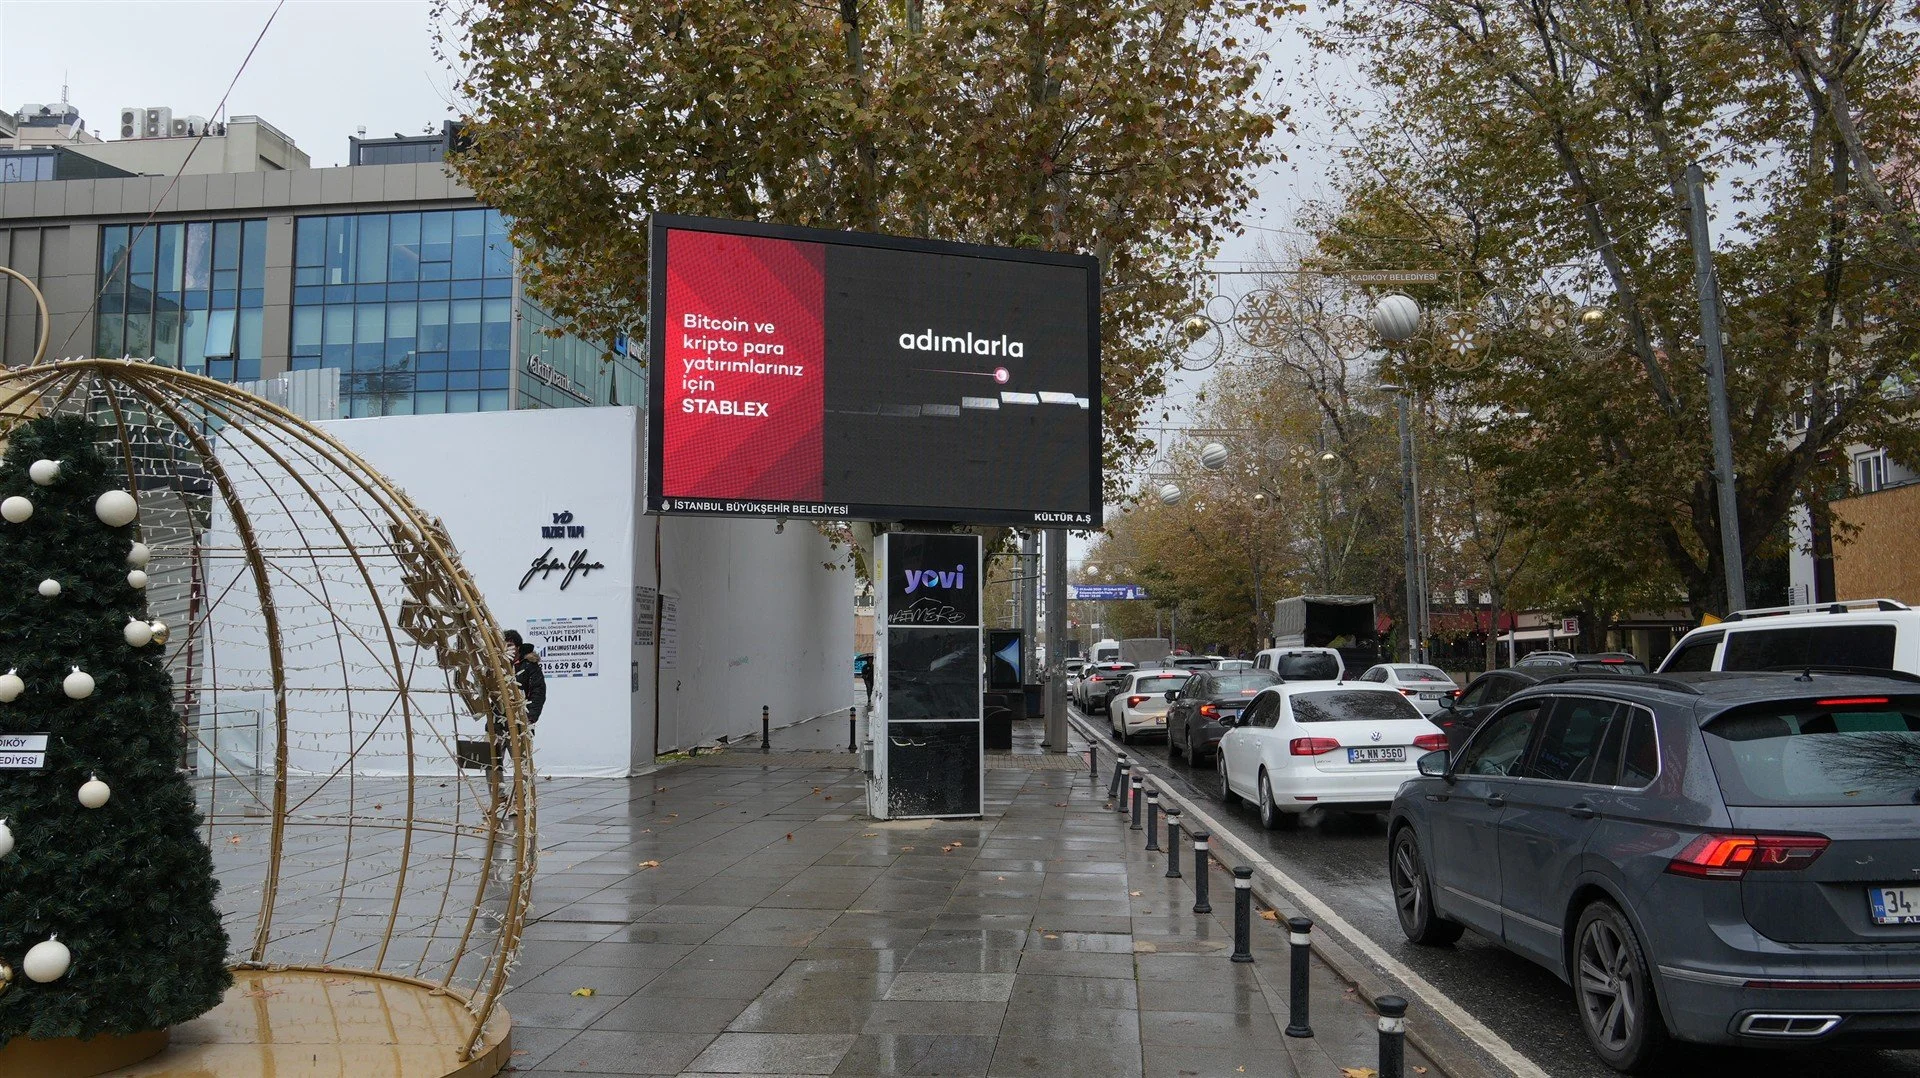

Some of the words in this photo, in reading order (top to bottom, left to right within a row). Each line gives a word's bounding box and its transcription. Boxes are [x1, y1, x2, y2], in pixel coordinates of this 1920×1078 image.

[683, 313, 749, 332] Bitcoin
[754, 322, 775, 334] ve
[683, 334, 738, 354] kripto
[743, 342, 784, 357] para
[899, 328, 1024, 358] adımlarla
[682, 357, 803, 376] yatırımlarınız
[682, 375, 715, 393] için
[682, 398, 769, 417] STABLEX
[674, 499, 723, 511] İSTANBUL
[726, 501, 790, 514] BÜYÜKŞEHİR
[792, 503, 848, 515] BELEDİYESİ
[1034, 512, 1073, 522] KÜLTÜR
[541, 525, 565, 539] YAZICI
[567, 525, 585, 539] YAPI
[904, 564, 964, 594] yovi
[554, 662, 569, 670] 629
[583, 661, 593, 669] 49
[1354, 749, 1365, 759] 34
[1367, 749, 1379, 759] NN
[1381, 748, 1402, 758] 3560
[1874, 904, 1884, 912] TR
[1885, 890, 1911, 913] 34
